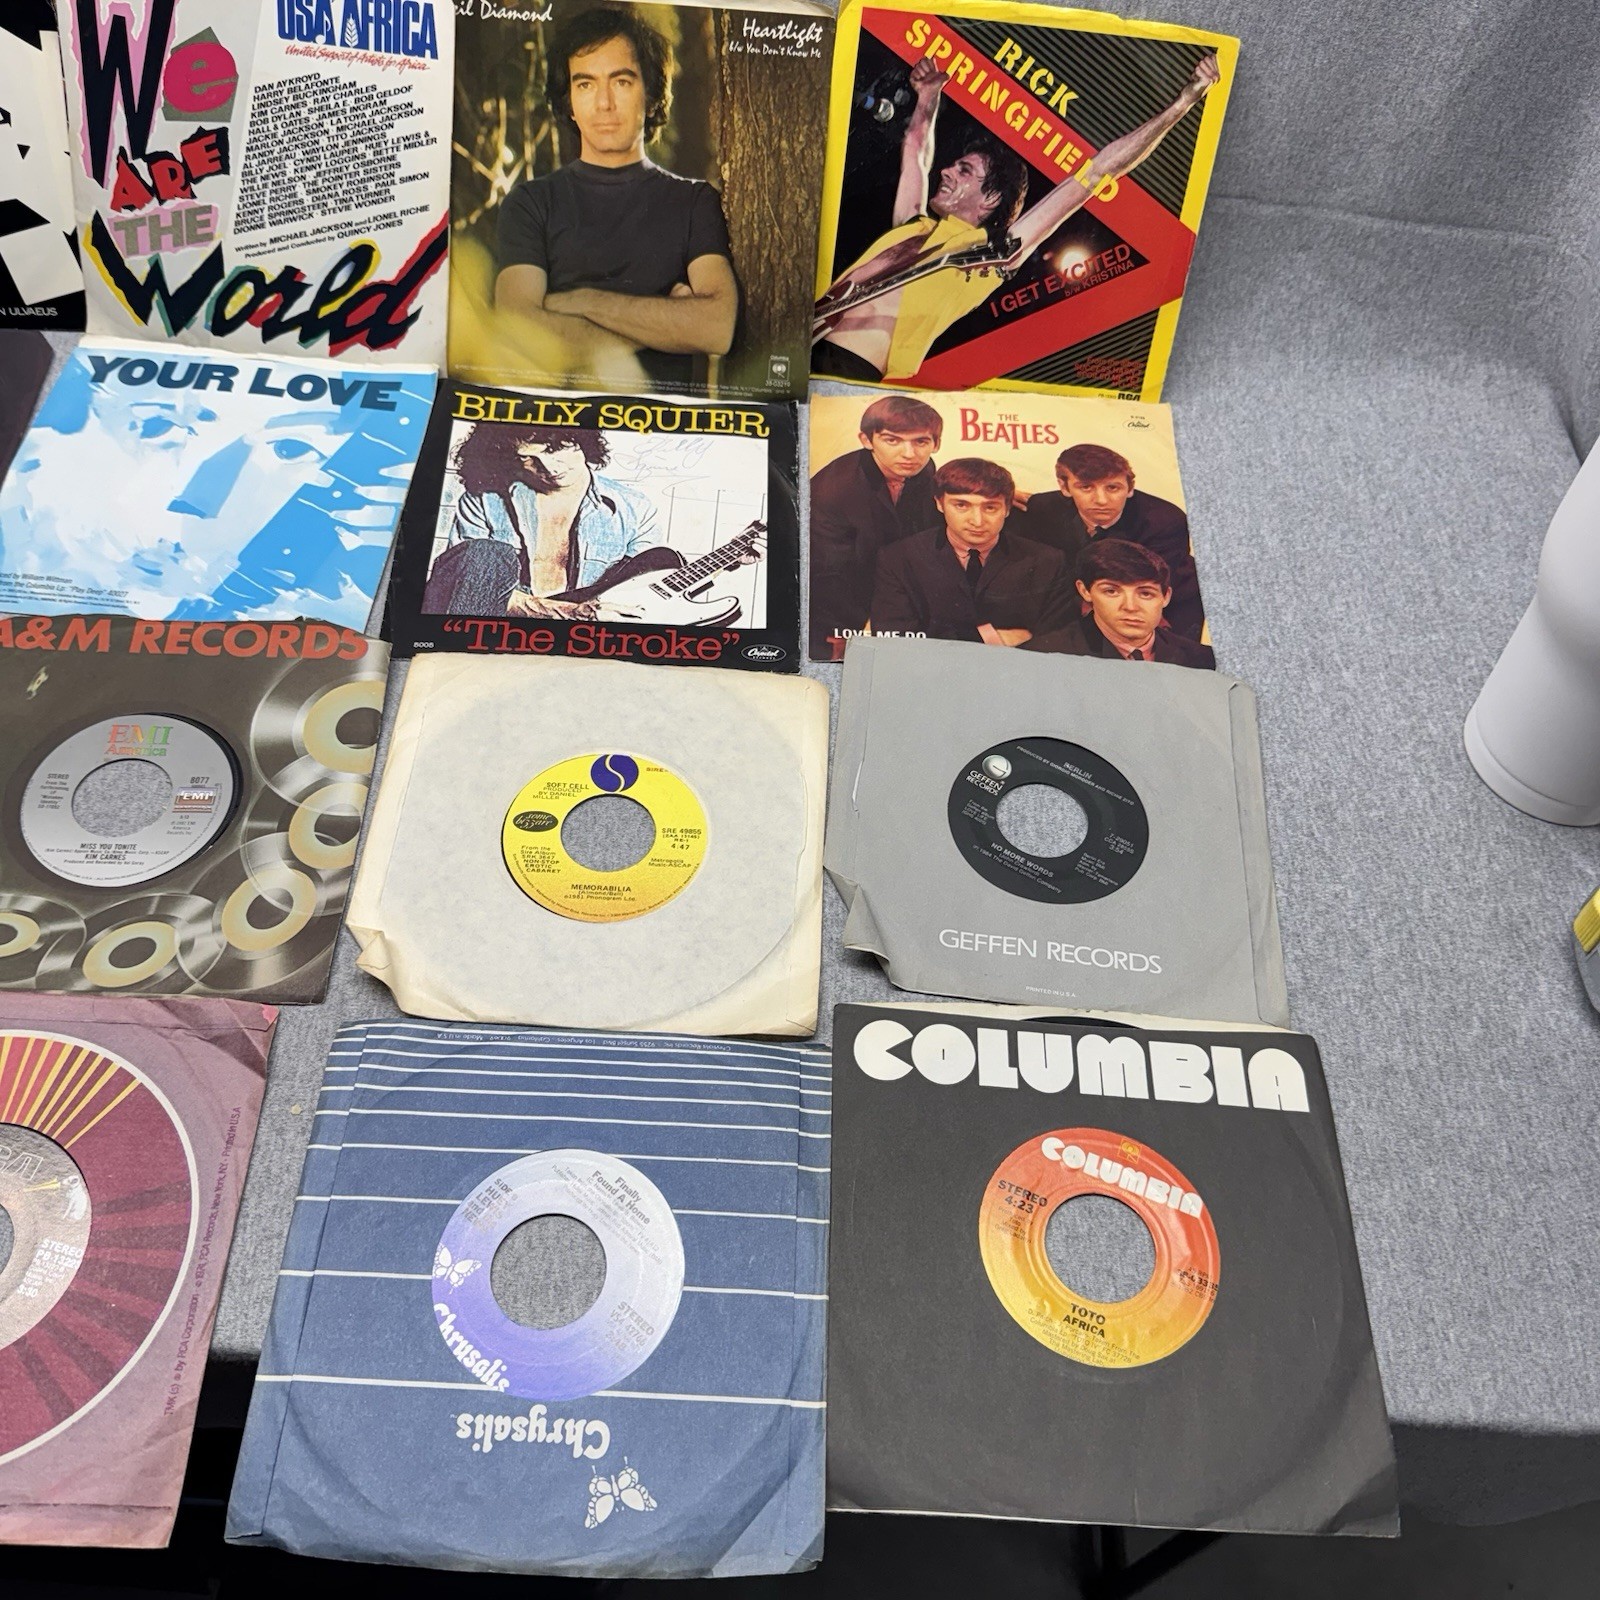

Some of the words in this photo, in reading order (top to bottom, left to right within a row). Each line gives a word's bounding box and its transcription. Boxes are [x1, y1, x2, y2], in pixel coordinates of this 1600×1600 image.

[480, 0, 553, 22] Diamond
[277, 0, 336, 46] USA
[340, 0, 438, 60] AFRICA
[743, 18, 823, 48] Heartlight
[285, 44, 317, 58] United
[396, 56, 430, 75] Africa
[746, 43, 761, 54] You
[762, 44, 785, 56] Don't
[787, 45, 809, 58] Know
[810, 47, 821, 59] Me
[253, 89, 284, 102] HARRY
[287, 76, 340, 95] BELAFONTE
[254, 83, 274, 94] DAN
[276, 72, 321, 88] AYKROYD
[993, 37, 1079, 118] RICK
[76, 0, 237, 188] We
[249, 118, 269, 128] BOB
[271, 110, 302, 123] DYLAN
[308, 102, 340, 115] SHEILA
[354, 94, 374, 104] BOB
[376, 84, 413, 99] GELDOF
[251, 110, 268, 119] KIM
[270, 100, 308, 115] CARNES
[313, 95, 331, 105] RAY
[333, 84, 377, 100] CHARLES
[252, 96, 290, 110] LINDSEY
[292, 81, 357, 102] BUCKINGHAM
[246, 132, 279, 145] JACKIE
[281, 121, 324, 137] JACKSON
[330, 118, 342, 126] LA
[343, 112, 367, 123] TOYA
[368, 101, 414, 117] JACKSON
[248, 126, 271, 136] HALL
[273, 123, 279, 131] &
[280, 116, 310, 129] OATES
[316, 108, 347, 121] JAMES
[349, 99, 387, 113] INGRAM
[905, 18, 1120, 203] SPRINGFIELD
[245, 149, 275, 161] RANDY
[277, 139, 320, 155] JACKSON
[327, 132, 348, 143] TITO
[350, 121, 395, 138] JACKSON
[246, 139, 284, 153] MARLON
[286, 128, 330, 144] JACKSON
[336, 118, 378, 133] MICHAEL
[379, 107, 424, 123] JACKSON
[242, 162, 254, 170] AL
[255, 152, 296, 168] JARREAU
[301, 142, 340, 157] WAYLON
[341, 132, 387, 148] JENNINGS
[111, 132, 222, 210] ARE
[113, 205, 214, 256] THE
[90, 211, 449, 347] World
[990, 301, 999, 318] I
[1001, 281, 1040, 313] GET
[1043, 243, 1131, 294] EXCITED
[1064, 285, 1081, 297] b/w
[1083, 260, 1135, 289] KRISTINA
[8, 307, 58, 317] ULVAEUS
[87, 355, 240, 394] YOUR
[248, 367, 403, 412] LOVE
[451, 391, 592, 427] BILLY
[598, 402, 770, 437] SQUIER
[959, 407, 1060, 450] BEATLES
[997, 413, 1020, 423] THE
[0, 616, 111, 653] A&M
[129, 621, 369, 661] RECORDS
[834, 627, 872, 639] LOVE
[876, 630, 900, 639] ME
[905, 631, 927, 639] DO
[108, 724, 174, 745] EMI
[104, 744, 167, 757] America
[190, 776, 210, 784] 8077
[546, 781, 568, 789] SOFT
[569, 782, 590, 790] CELL
[965, 775, 1000, 796] RECORDS
[969, 770, 1003, 791] GEFFEN
[1063, 761, 1093, 779] BERLIN
[182, 792, 211, 800] EMI
[990, 842, 1004, 852] NO
[1004, 848, 1026, 864] MORE
[1026, 859, 1054, 878] WORDS
[571, 883, 632, 892] MEMORABILIA
[939, 928, 1037, 958] GEFFEN
[1047, 940, 1162, 974] RECORDS
[1025, 985, 1052, 995] PRINTED
[854, 1019, 1310, 1113] COLUMBIA
[494, 1178, 513, 1194] SIDE
[614, 1176, 642, 1203] Finally
[998, 1179, 1048, 1207] STEREO
[1041, 1137, 1204, 1219] COLUMBIA
[592, 1170, 619, 1196] Found
[617, 1194, 627, 1203] A
[625, 1201, 651, 1225] Home
[1005, 1195, 1034, 1214] 4:23
[41, 1238, 83, 1258] STEREO
[181, 1293, 199, 1339] Corporation
[1063, 1314, 1105, 1338] AFRICA
[1070, 1303, 1106, 1326] TOTO
[178, 1340, 190, 1359] RCA
[456, 1404, 611, 1459] Chrysalis
